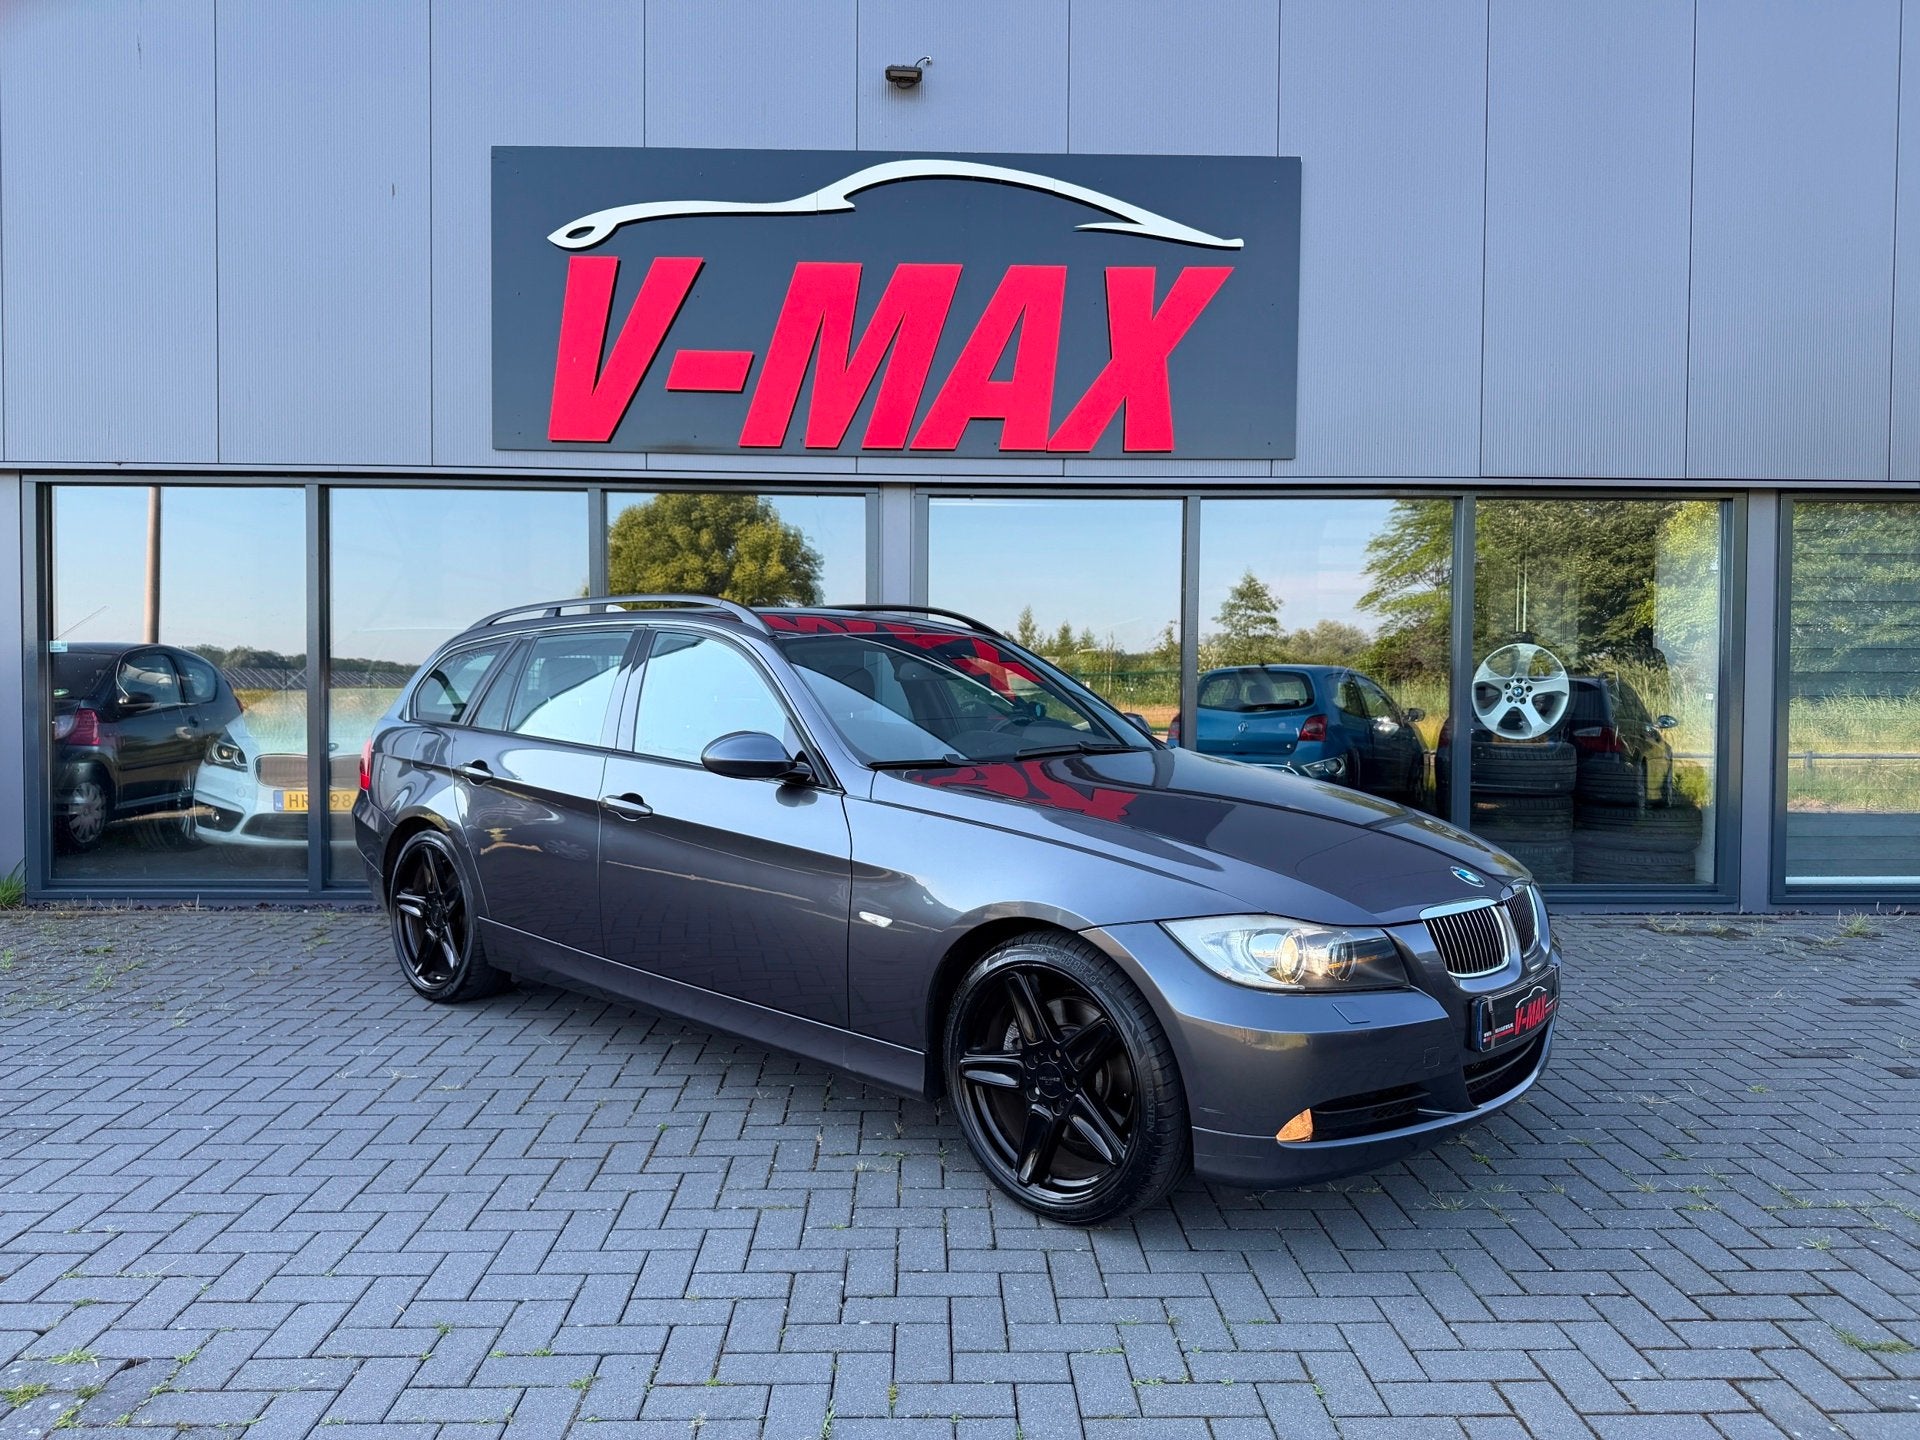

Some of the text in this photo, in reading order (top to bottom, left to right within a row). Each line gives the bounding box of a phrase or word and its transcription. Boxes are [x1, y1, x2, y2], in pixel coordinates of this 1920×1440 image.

[548, 256, 1234, 453] V-MAX
[330, 793, 352, 809] 98
[1514, 993, 1548, 1036] V-MAX
